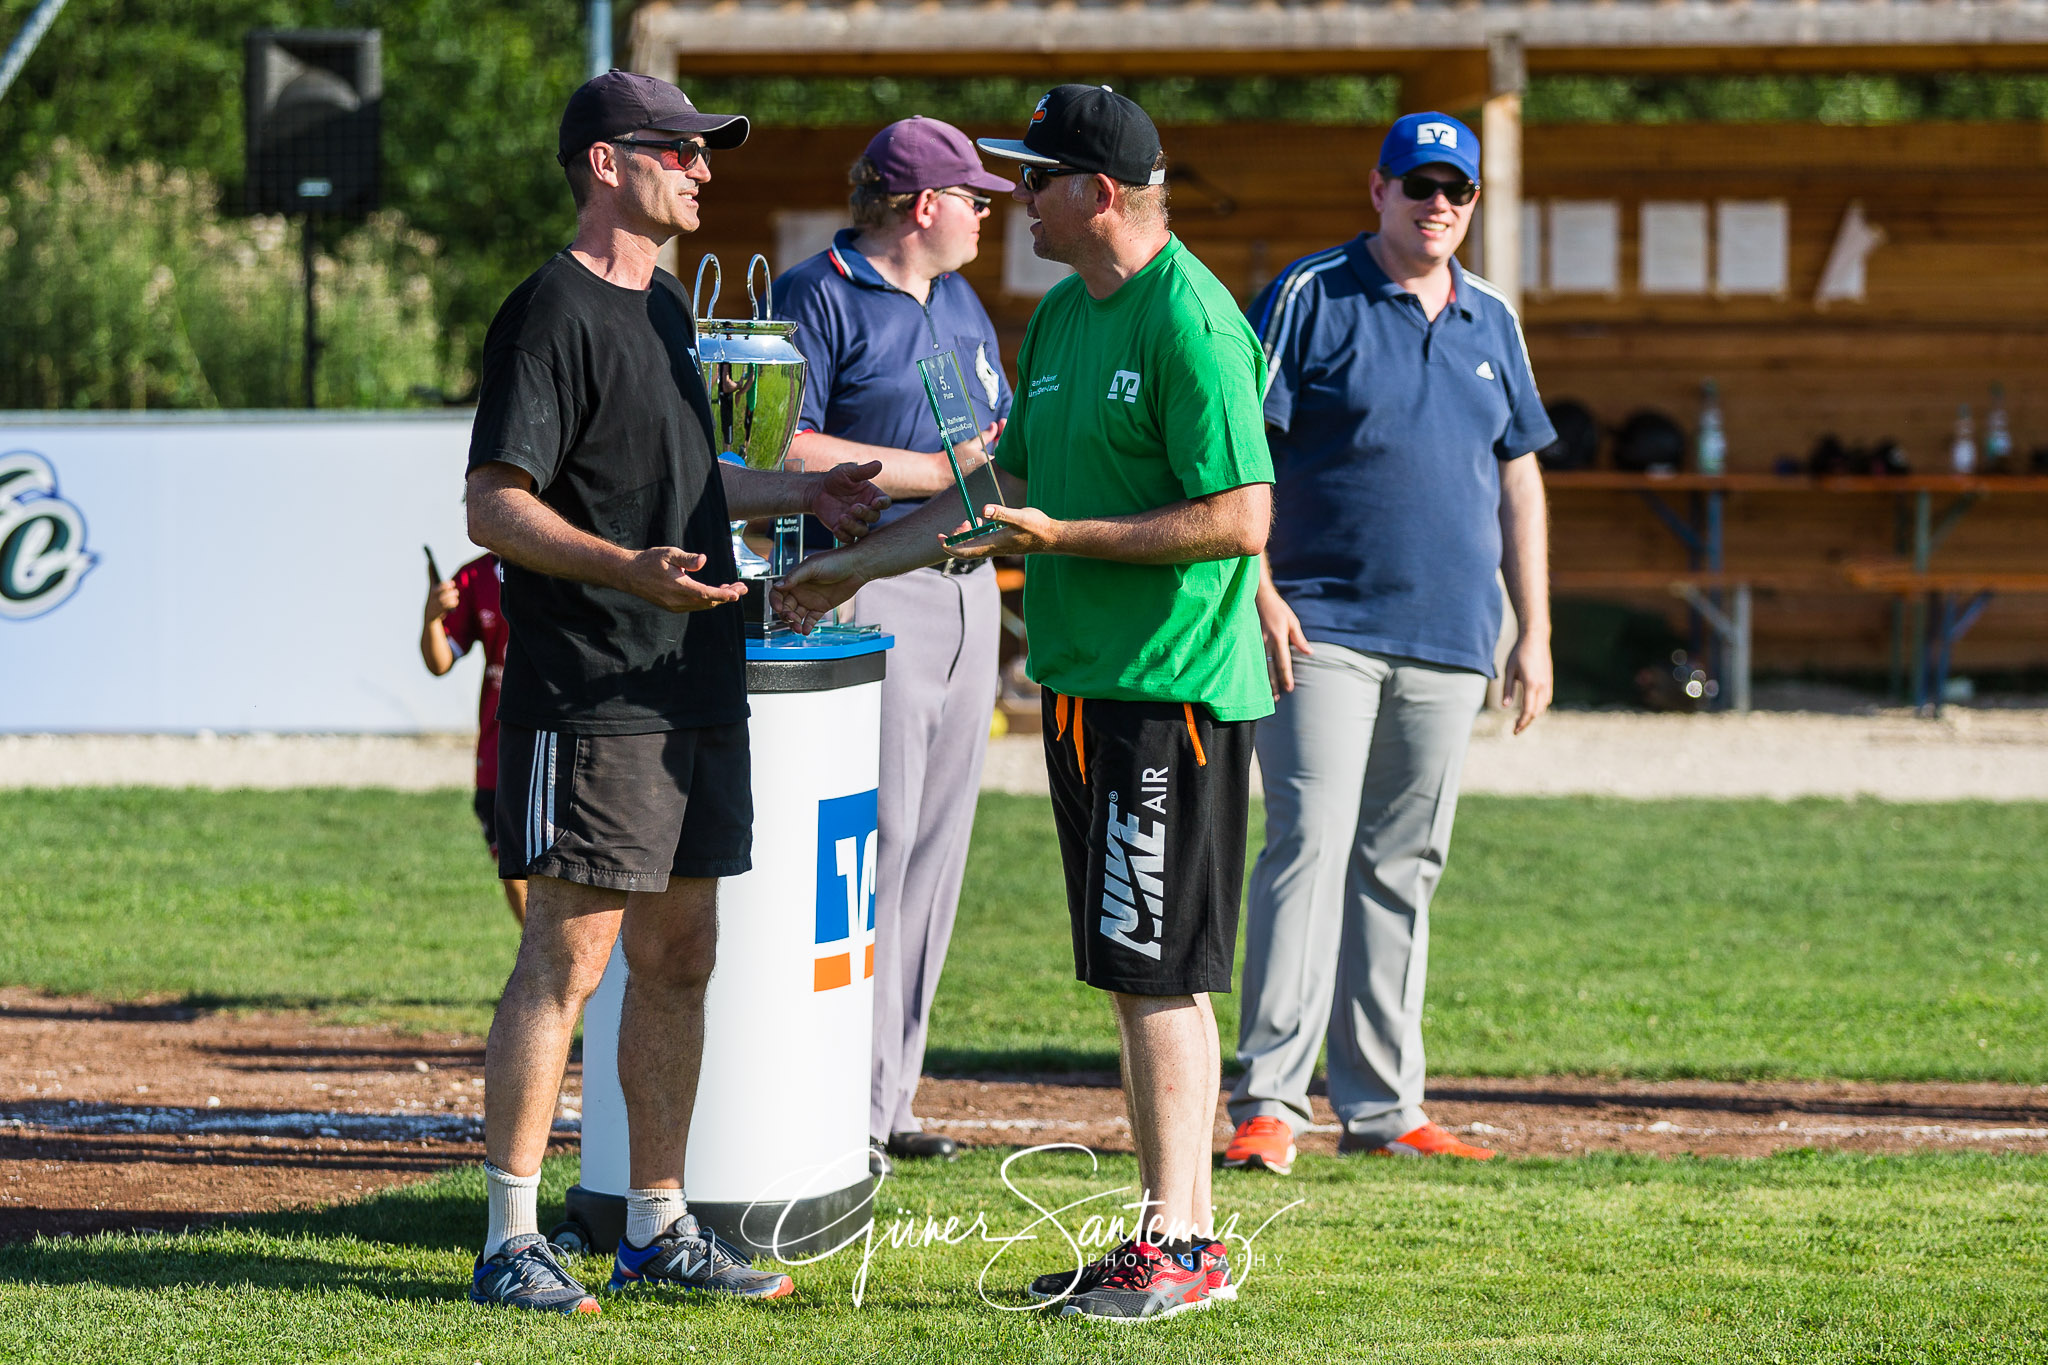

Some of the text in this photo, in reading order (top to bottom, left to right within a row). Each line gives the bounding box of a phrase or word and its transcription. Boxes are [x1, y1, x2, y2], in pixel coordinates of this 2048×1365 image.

[938, 375, 951, 391] 5.
[1141, 766, 1169, 814] AIR
[1100, 802, 1165, 960] NIKE
